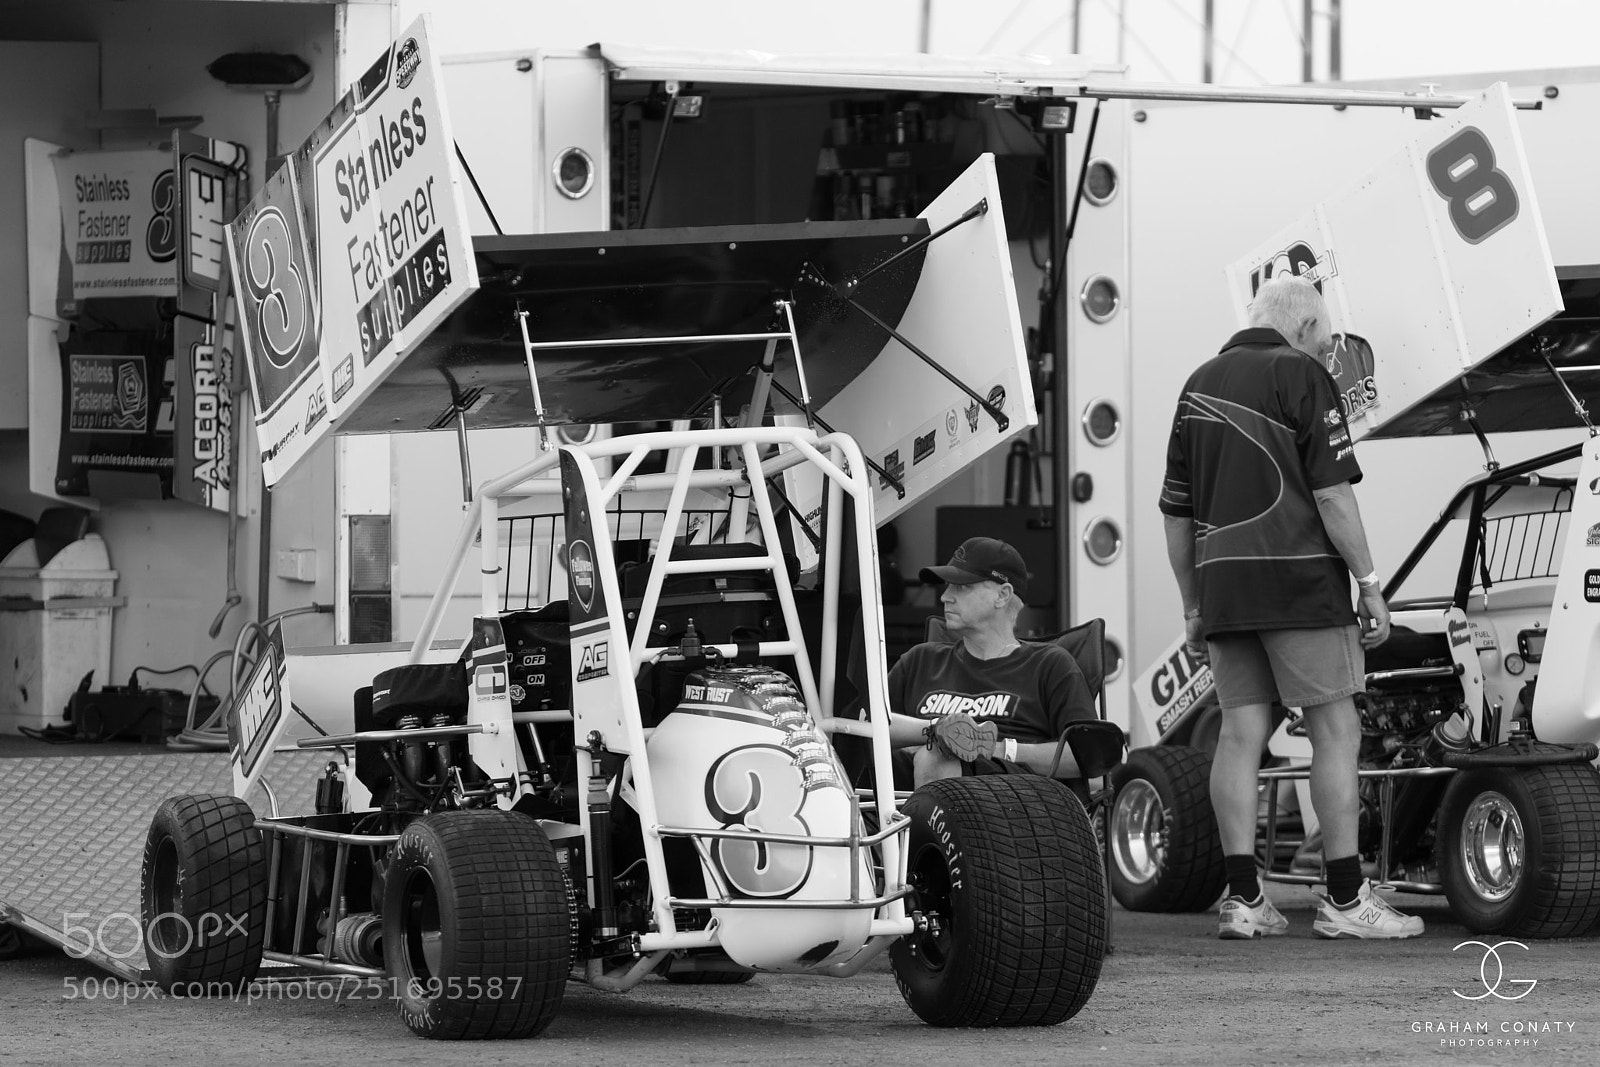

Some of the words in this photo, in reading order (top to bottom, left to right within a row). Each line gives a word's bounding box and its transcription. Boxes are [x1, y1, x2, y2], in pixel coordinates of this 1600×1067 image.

[335, 96, 426, 224] Stanless
[75, 173, 130, 203] Stainless
[1426, 125, 1520, 245] 8
[78, 209, 131, 238] Fastener
[77, 242, 130, 263] supplies
[245, 205, 306, 369] 3
[72, 360, 114, 384] Stainless
[73, 386, 115, 411] Fastener
[72, 412, 113, 430] supplies
[524, 656, 545, 665] OFF
[579, 641, 608, 674] AG
[528, 675, 544, 684] ON
[685, 684, 706, 701] WEST
[920, 693, 1010, 717] SIMPSON
[1160, 690, 1195, 731] SMASH
[705, 743, 813, 901] 3
[928, 805, 962, 890] Hoosier
